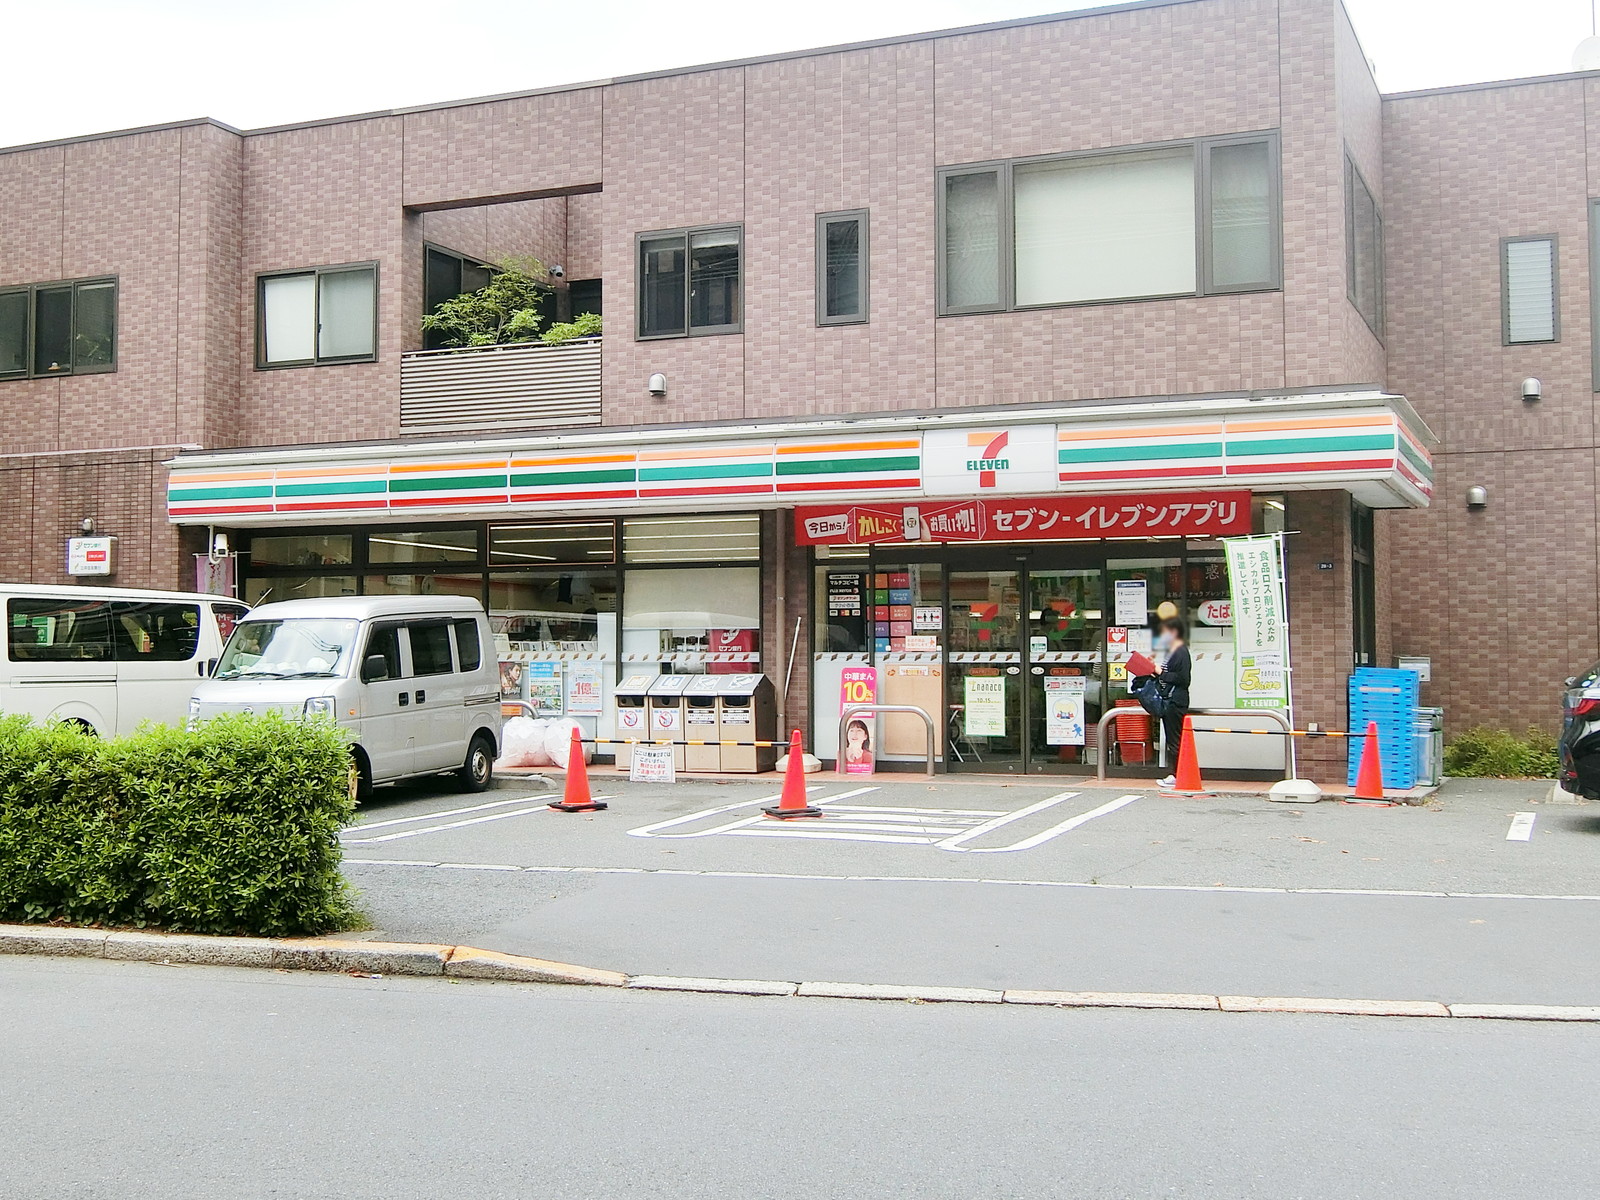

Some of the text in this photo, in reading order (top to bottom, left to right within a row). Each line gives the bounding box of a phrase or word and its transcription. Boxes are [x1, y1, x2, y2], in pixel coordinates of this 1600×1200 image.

[930, 508, 976, 533] お買い物!
[992, 499, 1237, 532] セブン-イレブンアプリ
[808, 520, 846, 534] 今日から!
[858, 515, 898, 537] かしこく
[1259, 550, 1276, 643] 食品ロス削減のため
[1207, 603, 1234, 619] たば
[844, 672, 874, 681] 中華まん
[976, 682, 1002, 692] nanaco
